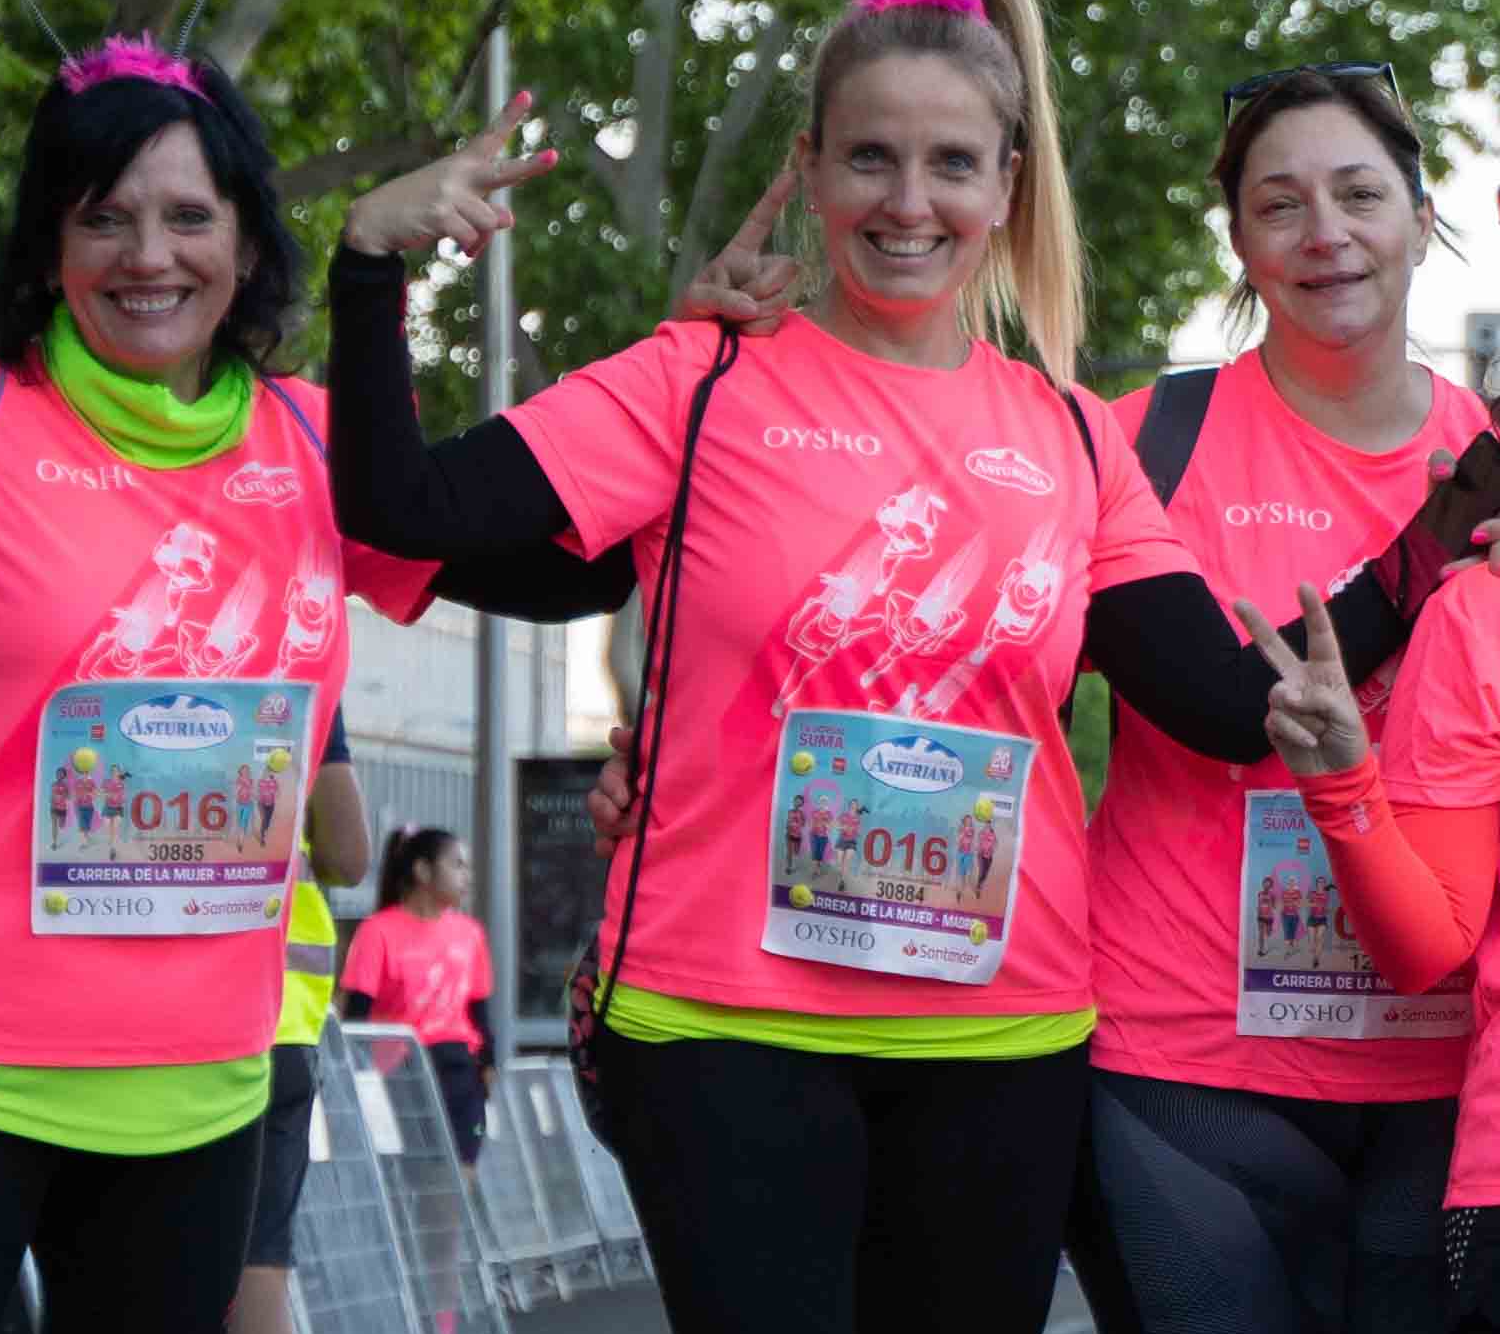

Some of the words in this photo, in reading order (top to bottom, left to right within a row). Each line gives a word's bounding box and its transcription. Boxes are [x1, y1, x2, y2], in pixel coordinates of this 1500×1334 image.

[763, 425, 882, 457] OYSHO
[1224, 501, 1334, 532] OYSHO
[126, 713, 229, 738] ASTURIANA
[798, 732, 844, 750] SUMA
[868, 751, 958, 785] ASTURIANA
[130, 790, 229, 832] 016
[147, 843, 205, 861] 30885
[863, 828, 949, 877] 016
[67, 867, 131, 882] CARRERA
[134, 867, 152, 881] DE
[155, 867, 170, 881] LA
[173, 867, 215, 881] MUJER
[875, 880, 926, 903] 30884
[66, 896, 155, 917] OYSHO
[809, 896, 858, 915] ARRERA
[860, 902, 877, 917] DE
[879, 905, 894, 920] LA
[896, 906, 933, 926] MUJER
[794, 921, 876, 952] OYSHO
[919, 939, 980, 966] Santander
[1272, 974, 1332, 989] CARRERA
[1336, 976, 1353, 990] DE
[1356, 976, 1373, 990] LA
[1268, 1001, 1354, 1024] OYSHO
